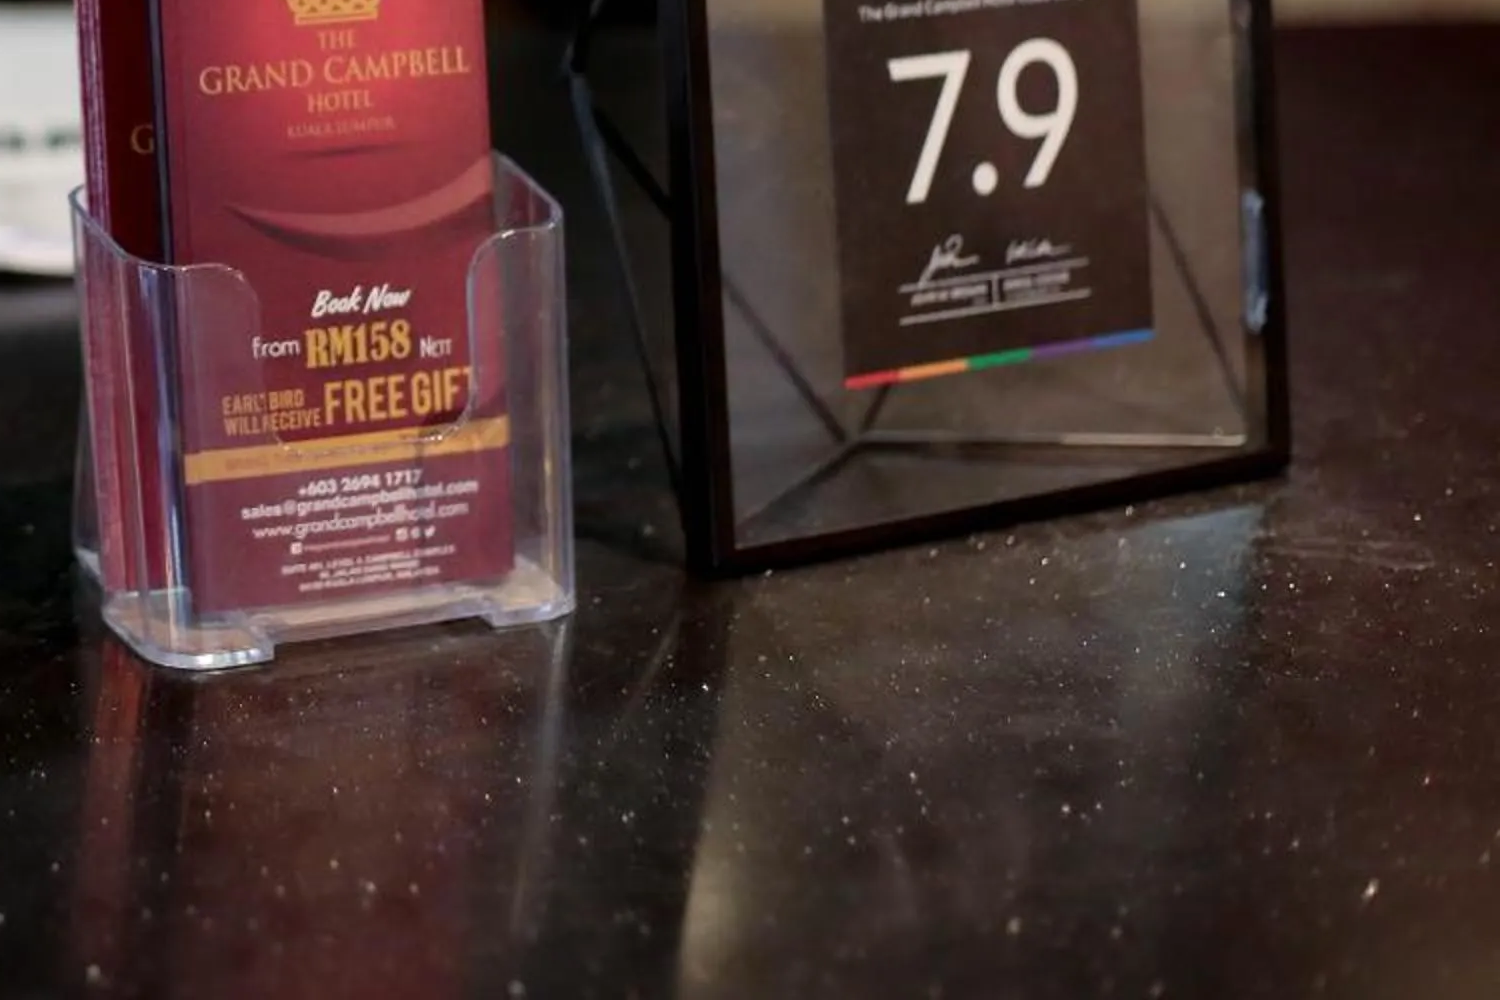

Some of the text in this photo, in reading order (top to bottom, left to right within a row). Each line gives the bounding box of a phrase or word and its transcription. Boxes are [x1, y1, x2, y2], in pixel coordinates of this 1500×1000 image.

[317, 29, 356, 50] THE
[199, 46, 471, 95] GRAND CAMPBELL
[307, 89, 375, 114] HOTEL
[887, 37, 1079, 204] 7.9
[311, 284, 412, 318] Book Now
[252, 336, 301, 360] from
[305, 318, 412, 369] RM158
[268, 388, 305, 411] BIRD
[324, 374, 408, 426] FREE
[224, 415, 261, 436] WILL
[384, 468, 423, 487] 1717
